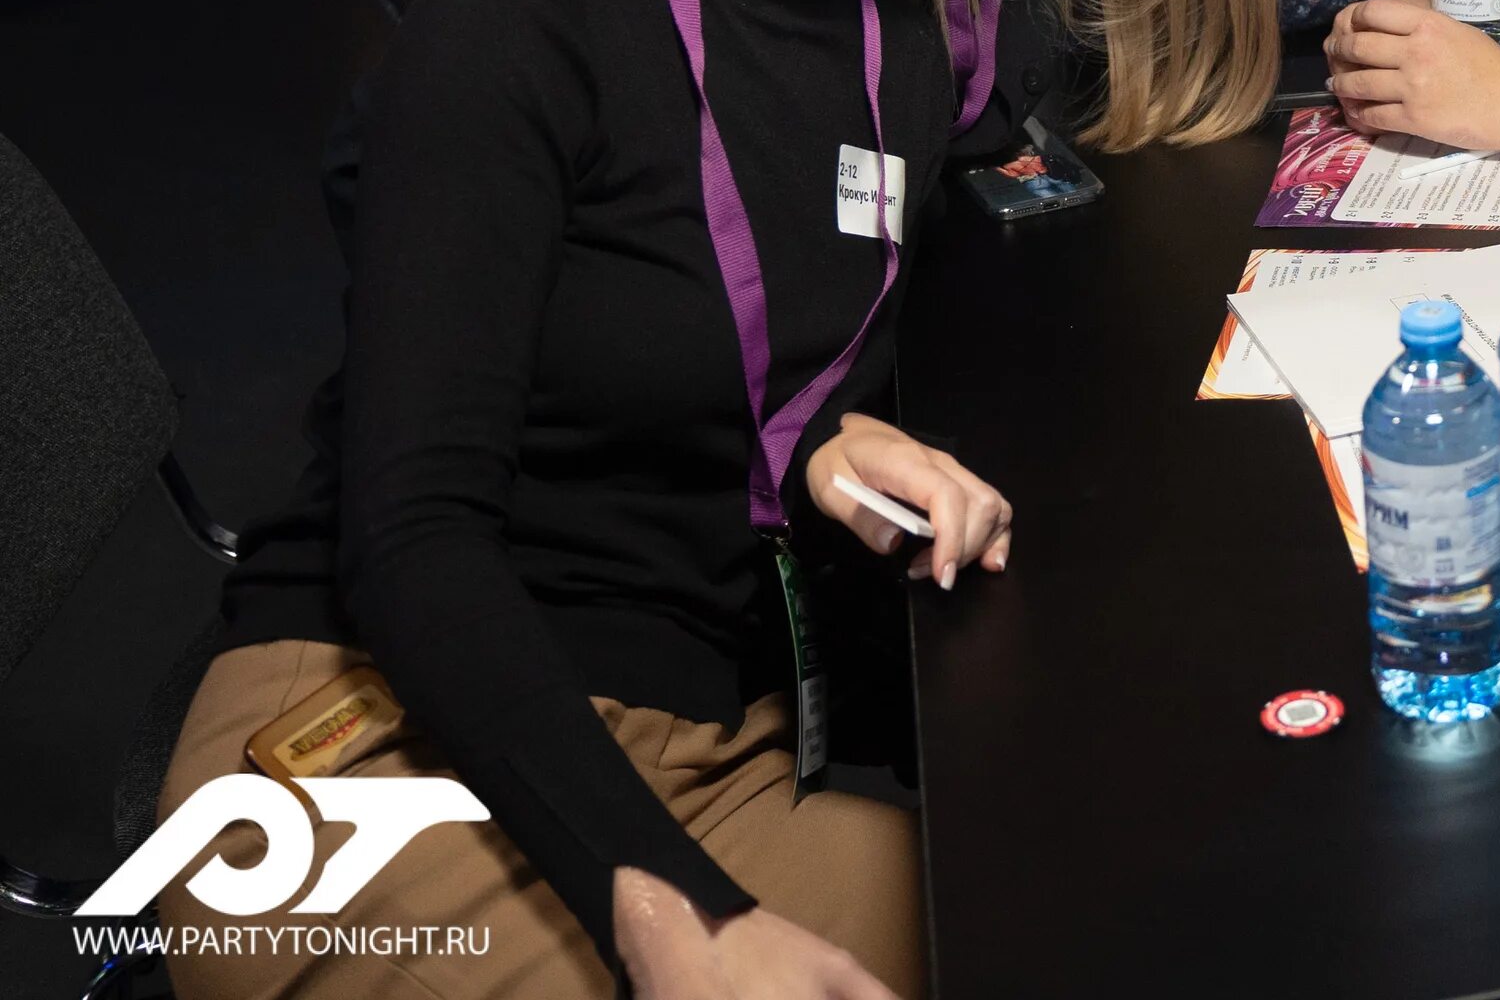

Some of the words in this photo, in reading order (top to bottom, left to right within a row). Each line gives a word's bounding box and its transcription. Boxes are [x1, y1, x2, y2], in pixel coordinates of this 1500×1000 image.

[840, 162, 857, 179] 2-12
[839, 184, 869, 204] Крокус
[871, 190, 896, 206] Иент
